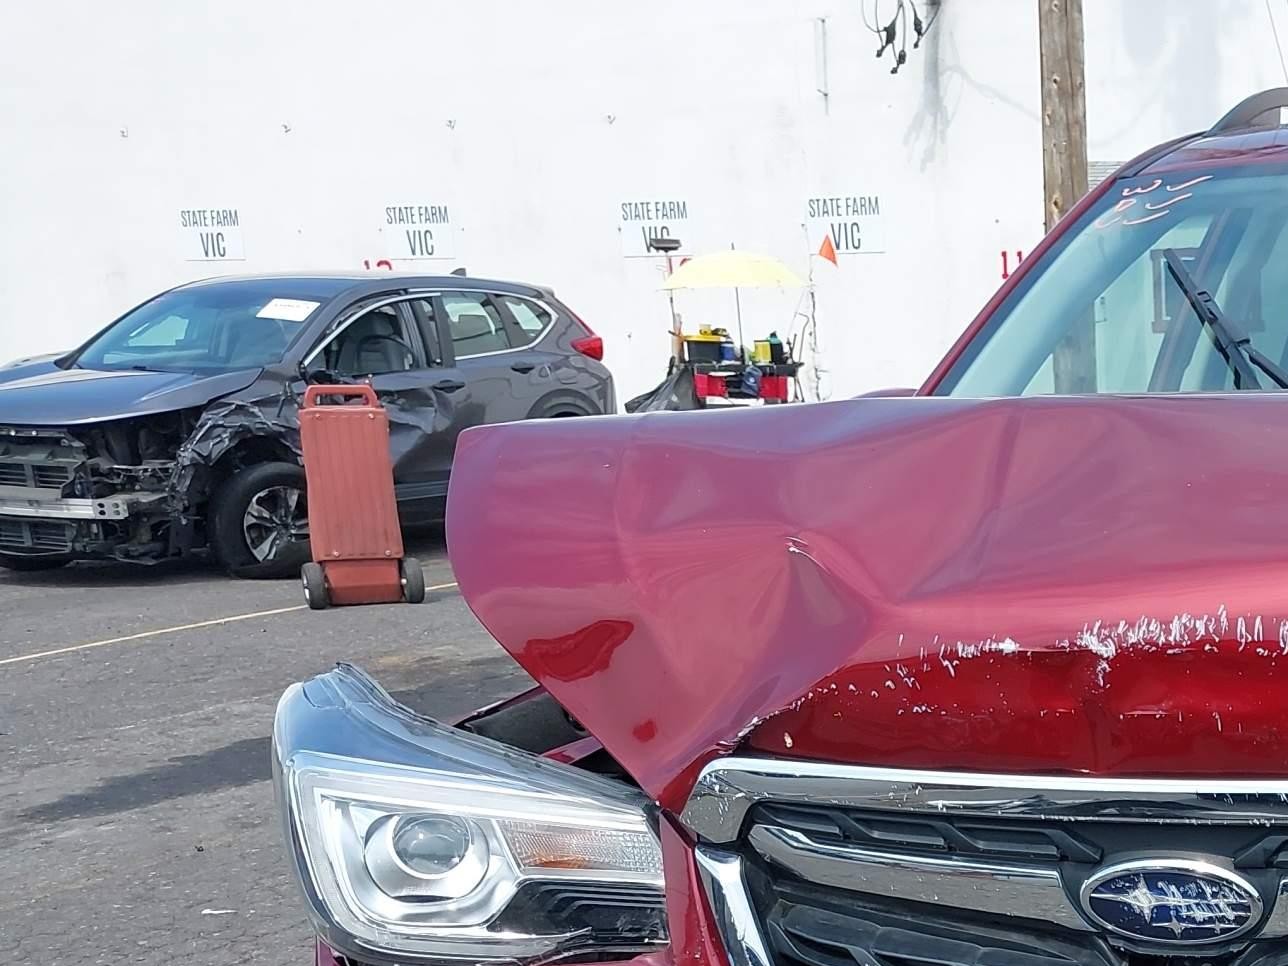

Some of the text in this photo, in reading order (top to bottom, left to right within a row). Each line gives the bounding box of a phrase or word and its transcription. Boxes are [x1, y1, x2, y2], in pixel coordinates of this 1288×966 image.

[386, 206, 449, 225] STATE FARM
[621, 201, 688, 221] STATE FARM
[808, 196, 880, 218] STATE FARM
[181, 210, 239, 228] STATE FARM
[200, 232, 226, 258] VIC
[406, 229, 434, 256] VIC
[831, 222, 861, 250] VIC
